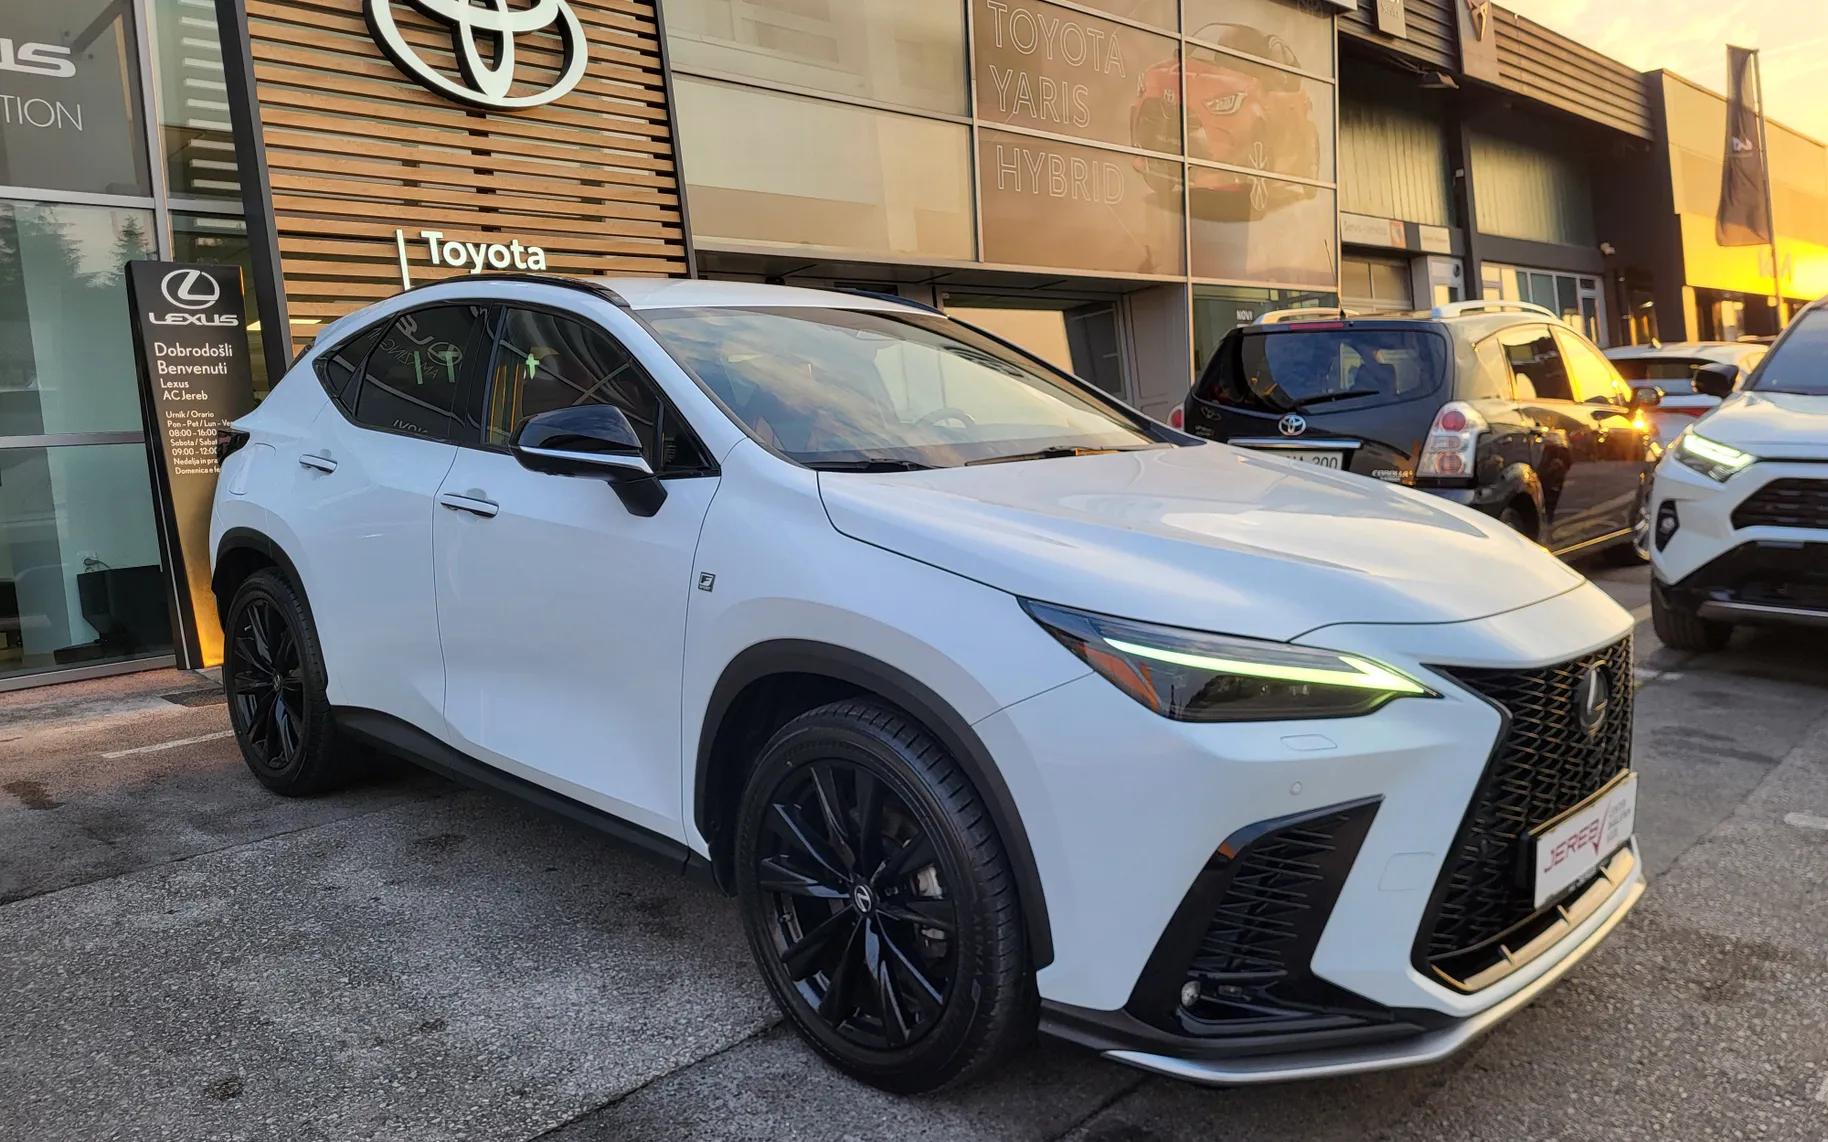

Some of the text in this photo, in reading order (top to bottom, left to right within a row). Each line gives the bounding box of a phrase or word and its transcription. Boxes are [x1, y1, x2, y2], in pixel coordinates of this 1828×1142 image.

[987, 0, 1126, 79] TOYOTA
[989, 64, 1091, 128] YARIS
[996, 144, 1125, 205] HYBRID
[420, 230, 547, 274] Toyota
[148, 312, 239, 327] LEXUS
[154, 342, 233, 357] Dobrodošli
[157, 360, 228, 375] Benvenuti
[160, 378, 190, 389] Lexus
[165, 410, 186, 419] Urnik
[190, 410, 215, 418] Orario
[167, 420, 182, 428] Pon
[186, 419, 199, 427] Pet
[221, 419, 232, 427] Ve
[168, 429, 192, 437] 08:00
[197, 428, 217, 436] 16:00
[170, 439, 194, 447] Sobota
[199, 438, 218, 446] Sabat
[171, 448, 194, 456] 09:00
[173, 457, 200, 466] Nedelja
[175, 466, 209, 475] Domenica
